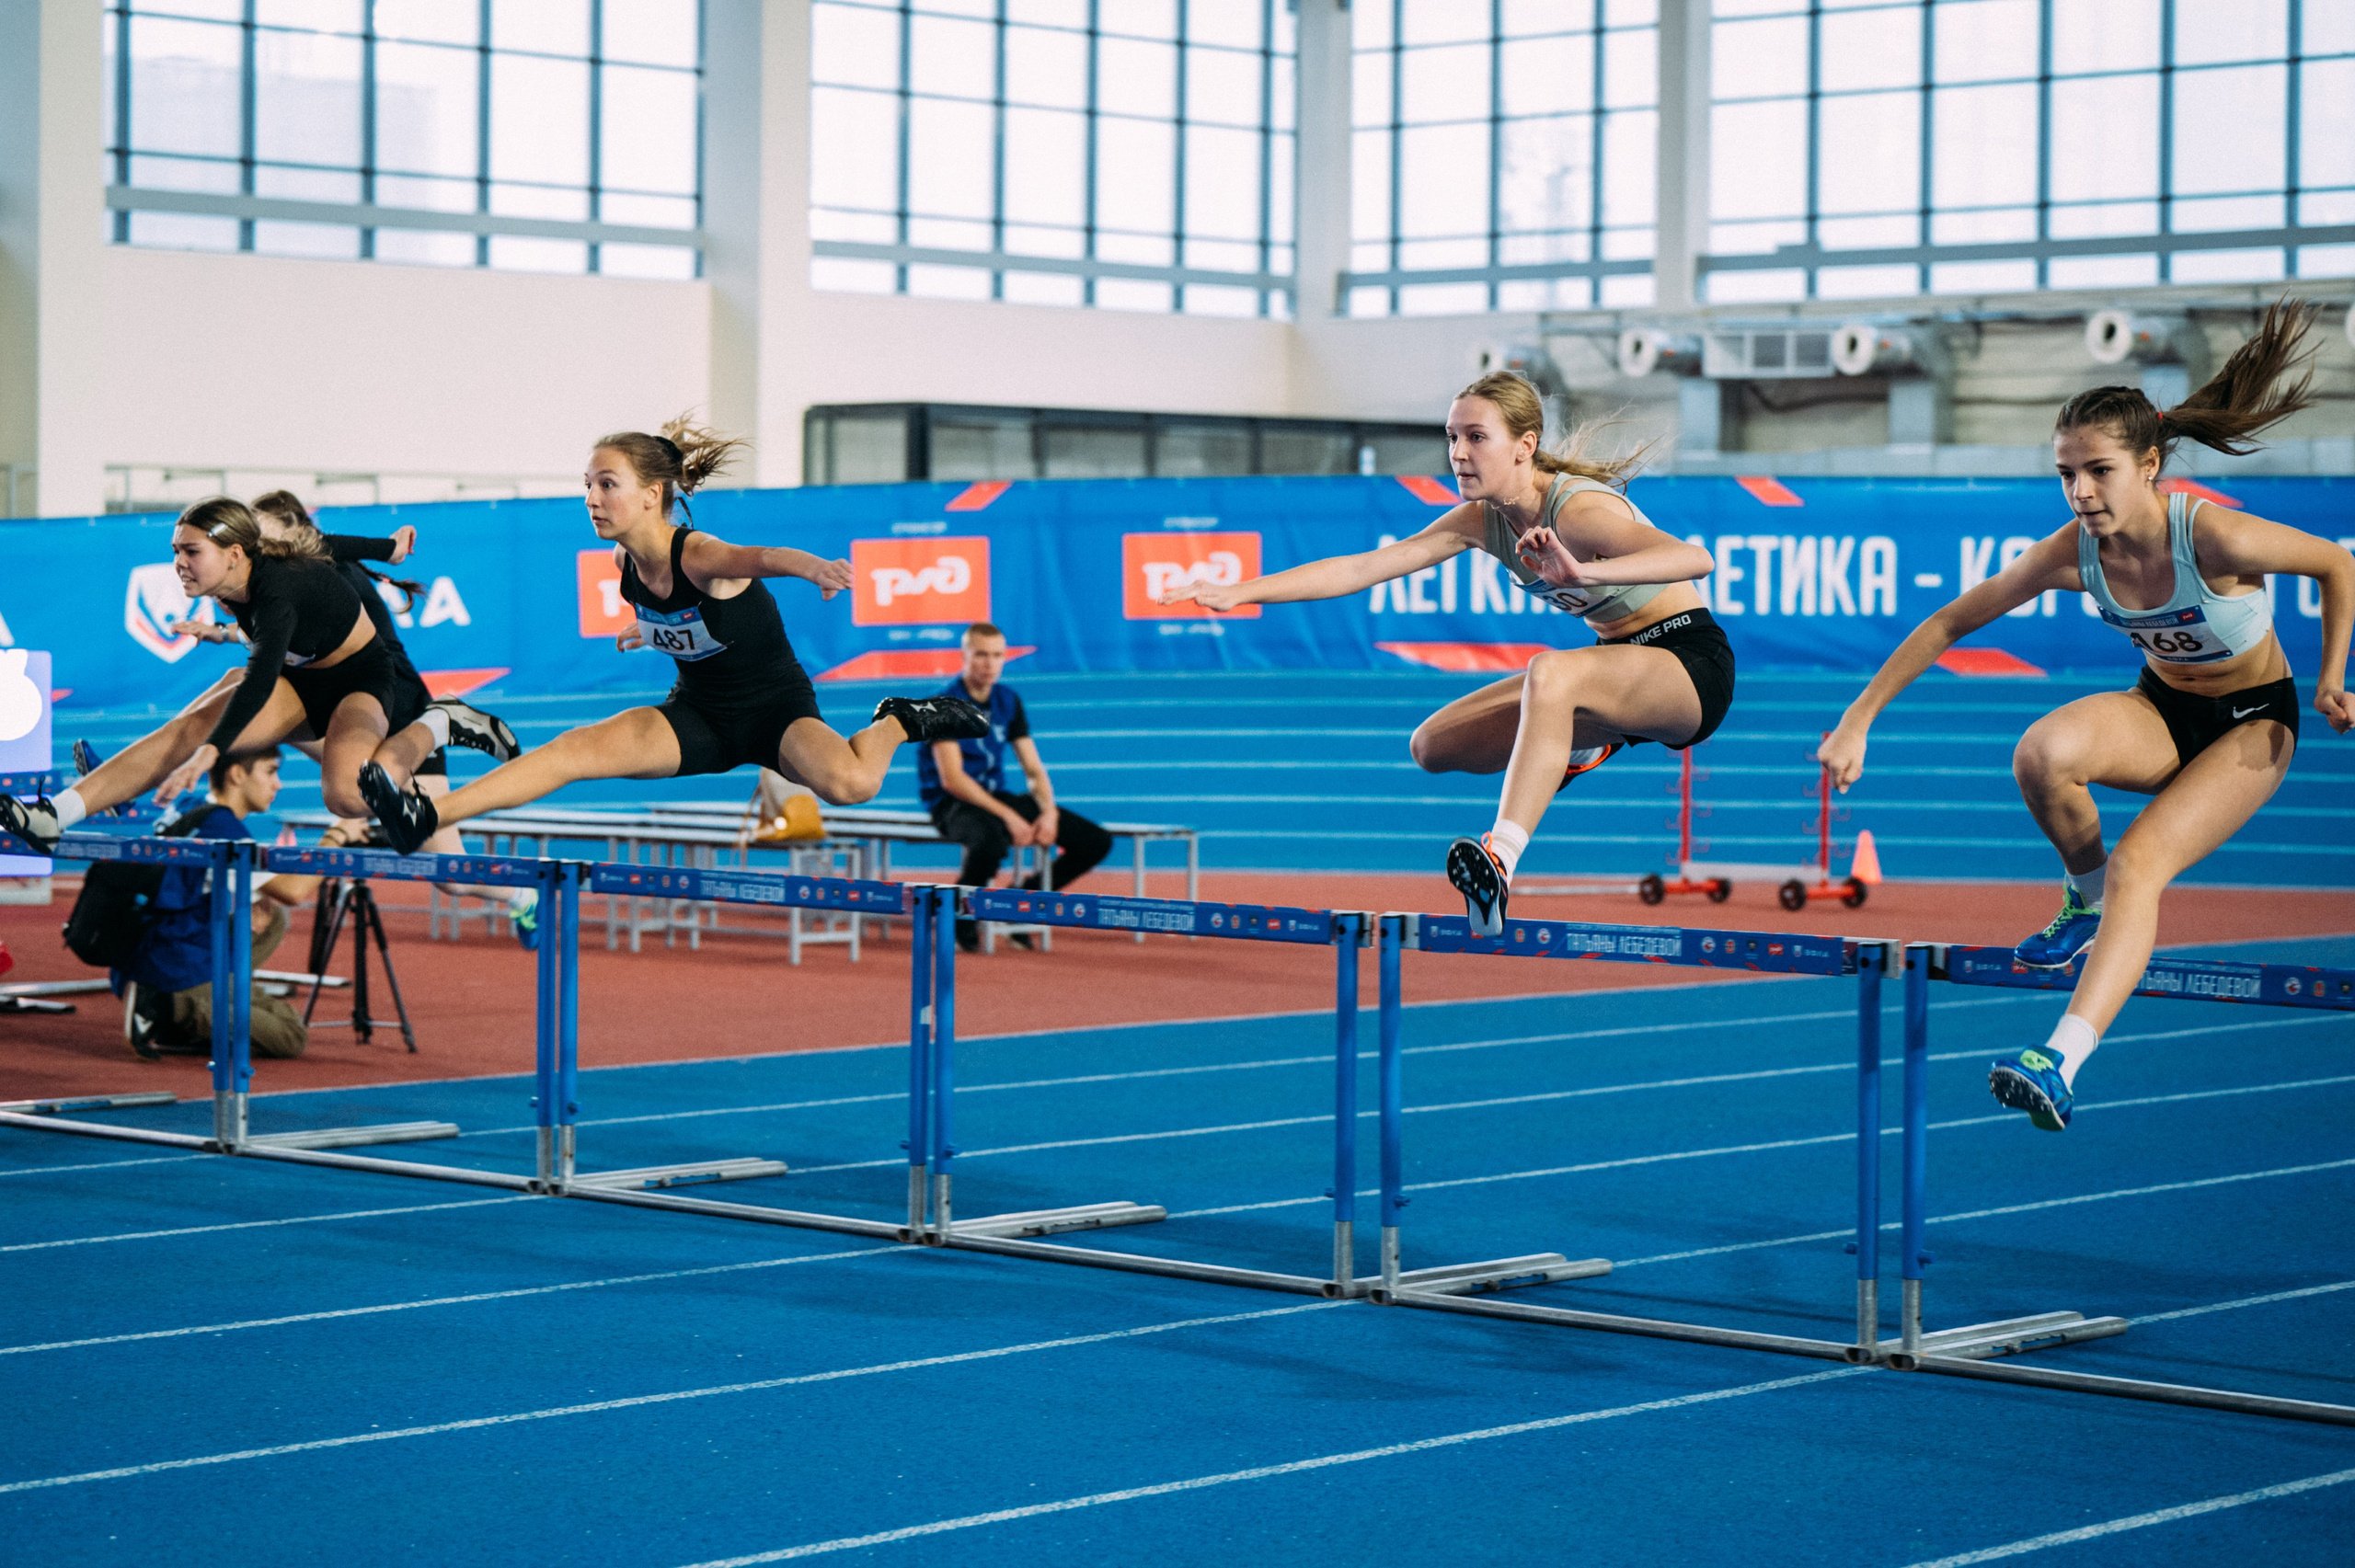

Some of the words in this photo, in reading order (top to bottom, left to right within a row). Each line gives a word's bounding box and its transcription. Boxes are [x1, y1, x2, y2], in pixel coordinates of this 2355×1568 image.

[652, 628, 696, 651] 487
[1630, 626, 1662, 646] NIKE
[1662, 614, 1692, 634] PRO
